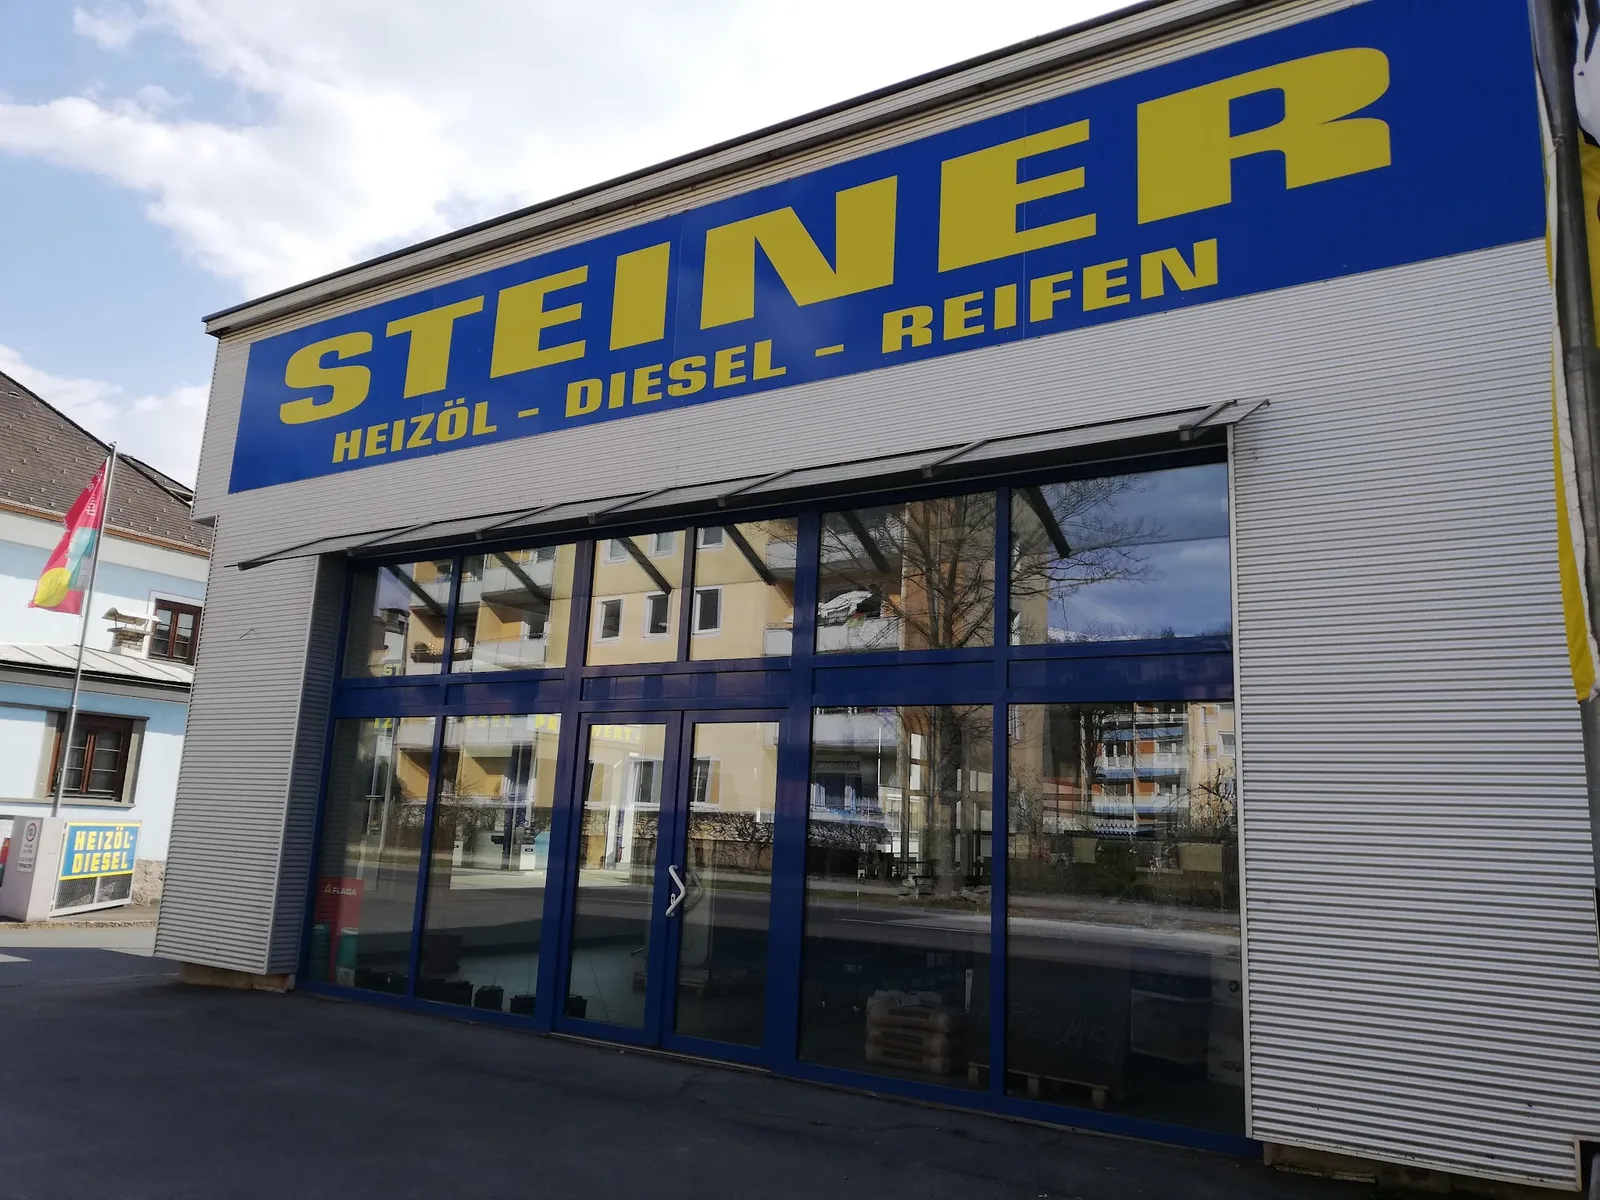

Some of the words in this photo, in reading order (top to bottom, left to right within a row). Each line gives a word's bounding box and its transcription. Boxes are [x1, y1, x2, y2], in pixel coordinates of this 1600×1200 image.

[279, 47, 1392, 425] STEINER
[332, 397, 497, 463] HEIZÖL
[565, 339, 787, 417] DIESEL
[882, 238, 1219, 354] REIFEN
[71, 852, 129, 873] DIESEL
[332, 887, 357, 896] FLAGA
